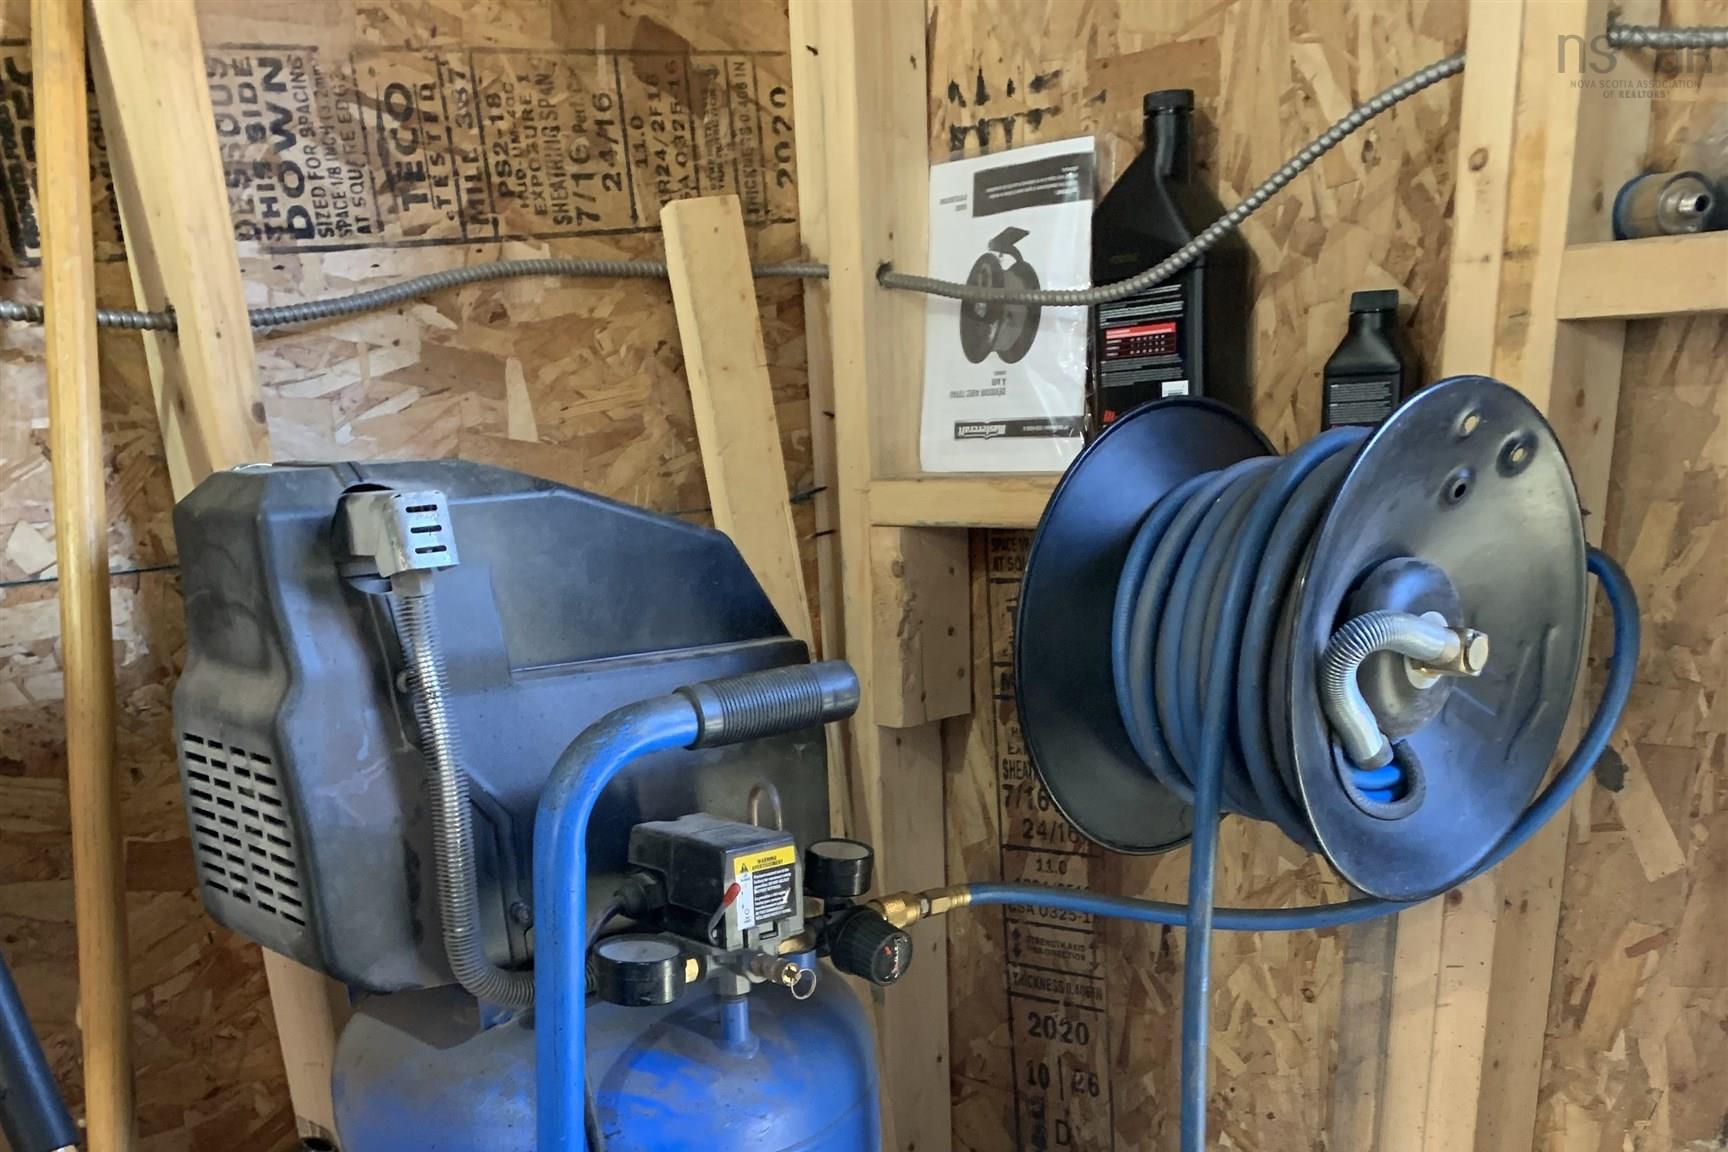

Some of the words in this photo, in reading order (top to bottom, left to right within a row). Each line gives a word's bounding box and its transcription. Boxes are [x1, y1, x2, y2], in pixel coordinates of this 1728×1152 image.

[732, 61, 747, 78] IN
[232, 55, 267, 145] SIDE
[289, 56, 316, 137] SPACING
[534, 73, 558, 121] SPAN
[257, 56, 315, 239] DOWN
[303, 144, 325, 180] FOR
[383, 82, 429, 212] TECO
[485, 92, 519, 198] PS2-18
[519, 95, 548, 216] EXPOSURE
[591, 92, 623, 192] 24/16
[629, 115, 649, 168] 11.0
[253, 160, 284, 240] THIS
[328, 166, 343, 185] 1/8
[540, 125, 574, 225] SHEATHING
[568, 143, 601, 226] 7/16
[311, 186, 335, 238] SIZED
[333, 191, 352, 237] SPACE
[354, 214, 372, 234] AT
[1002, 780, 1050, 812] 7/16
[1022, 818, 1081, 843] 24/16
[1036, 858, 1067, 875] 11.0
[1028, 1011, 1089, 1046] 2020
[1025, 1059, 1050, 1090] 10
[1056, 1118, 1072, 1146] D
